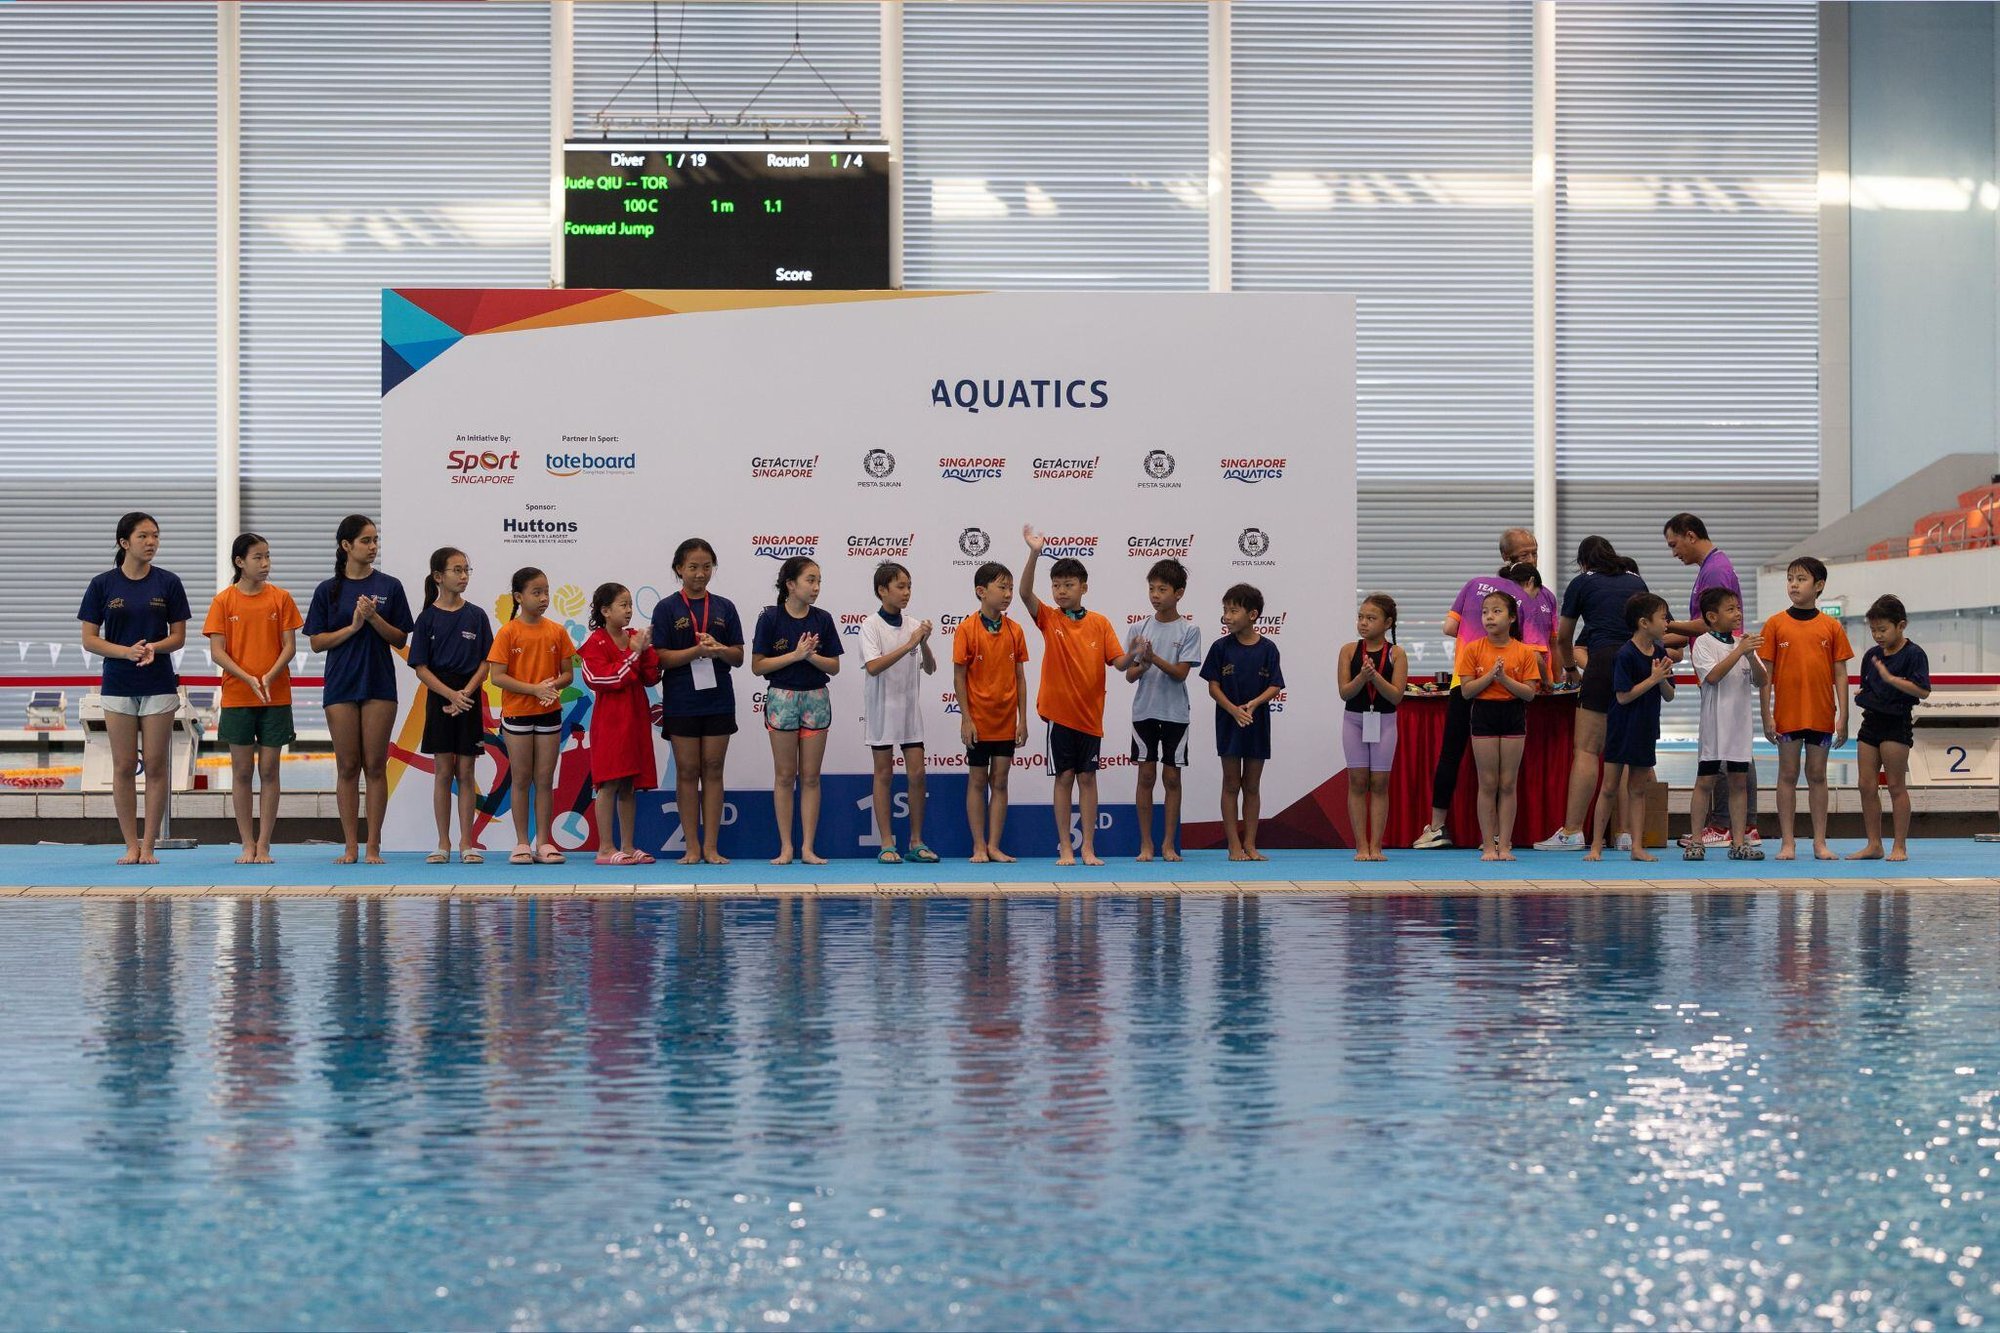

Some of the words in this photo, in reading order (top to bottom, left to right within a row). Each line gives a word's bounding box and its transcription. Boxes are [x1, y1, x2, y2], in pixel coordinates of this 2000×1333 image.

[610, 153, 646, 167] Diver
[665, 153, 673, 167] 1
[690, 153, 707, 167] 19
[767, 153, 810, 167] Round
[830, 154, 838, 167] 1
[853, 154, 863, 167] 4
[564, 176, 595, 190] Jude
[596, 176, 622, 191] QIU
[640, 176, 669, 190] TOR
[763, 199, 782, 213] 1.1
[564, 221, 617, 235] Forward
[618, 221, 655, 239] Jump
[775, 267, 813, 282] Score
[931, 379, 1109, 413] AQUATICS
[456, 434, 466, 442] An
[467, 434, 498, 442] Initiative
[561, 435, 588, 443] Partner
[589, 435, 597, 443] In
[597, 435, 620, 445] Sport:
[446, 450, 520, 473] Sport
[938, 457, 1006, 468] SINGAPORE
[1220, 458, 1287, 469] SINGAPORE
[751, 469, 813, 478] SINGAPORE
[941, 469, 1003, 481] AQUATICS
[1033, 470, 1094, 479] SINGAPORE
[1222, 469, 1283, 482] AQUATICS
[450, 475, 515, 485] SINGAPORE
[525, 503, 557, 512] Sponsor:
[503, 518, 578, 532] Huttons
[751, 535, 820, 546] SINGAPORE
[1042, 536, 1099, 546] NGAPORE
[754, 547, 815, 558] AQUATICS
[847, 548, 909, 557] SINGAPORE
[1127, 548, 1188, 557] SINGAPORE
[1946, 745, 1971, 773] 2
